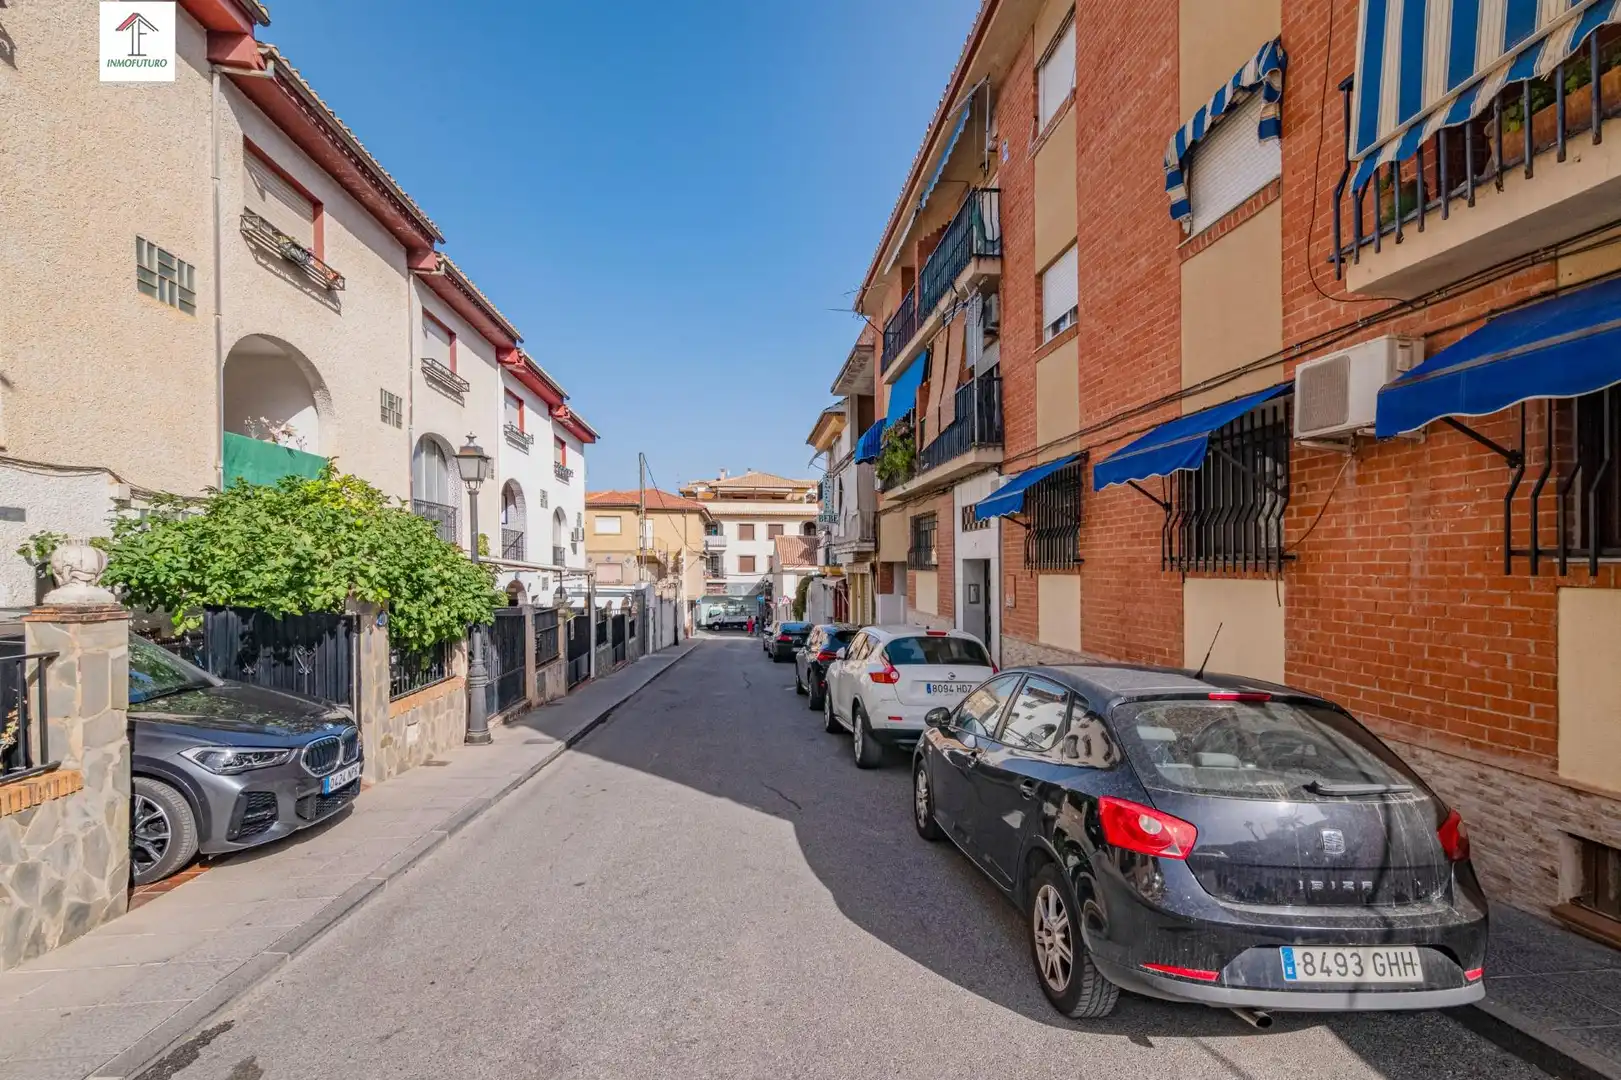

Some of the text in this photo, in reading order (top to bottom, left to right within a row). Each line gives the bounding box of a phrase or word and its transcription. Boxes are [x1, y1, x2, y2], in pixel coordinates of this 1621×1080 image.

[932, 684, 954, 693] 8094
[1302, 951, 1417, 978] 8493 GHH
